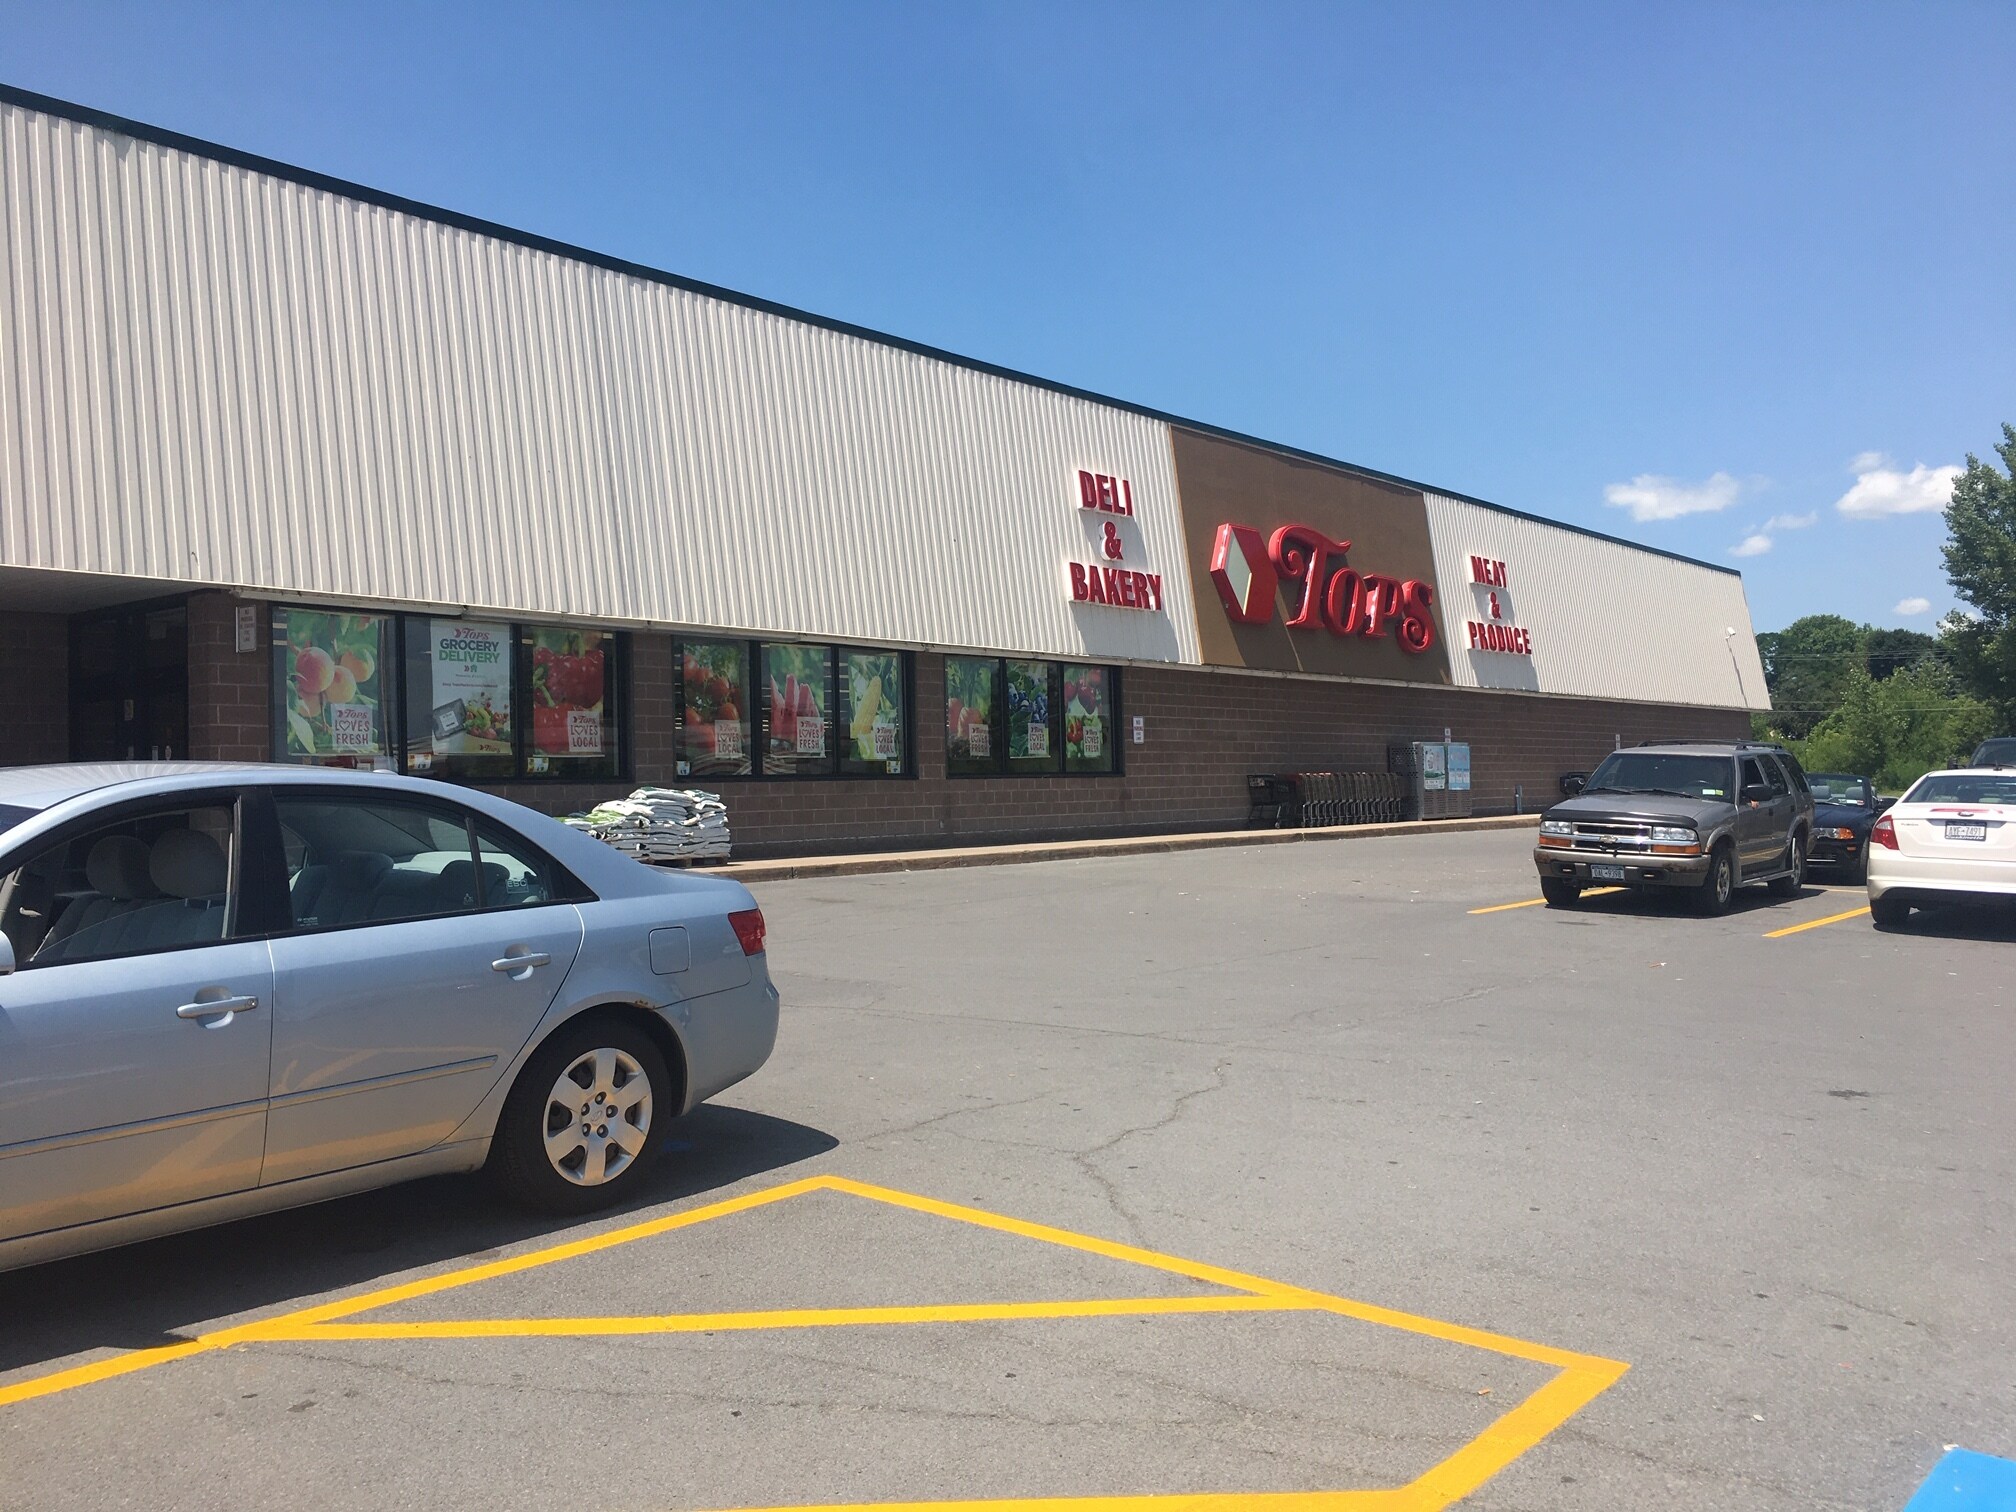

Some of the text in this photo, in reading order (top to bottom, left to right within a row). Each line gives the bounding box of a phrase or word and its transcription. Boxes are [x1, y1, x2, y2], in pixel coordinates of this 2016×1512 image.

[1077, 469, 1133, 516] DELI
[1102, 521, 1123, 560] &
[1469, 555, 1506, 588] MEAT
[1069, 562, 1161, 611] BAKERY
[1489, 591, 1502, 619] &
[440, 638, 499, 652] GROCERY
[1467, 621, 1532, 654] PRODUCE
[439, 650, 500, 664] DELIVERY
[336, 733, 369, 745] FRESH
[572, 736, 599, 748] LOCAL
[800, 739, 820, 749] FRESH
